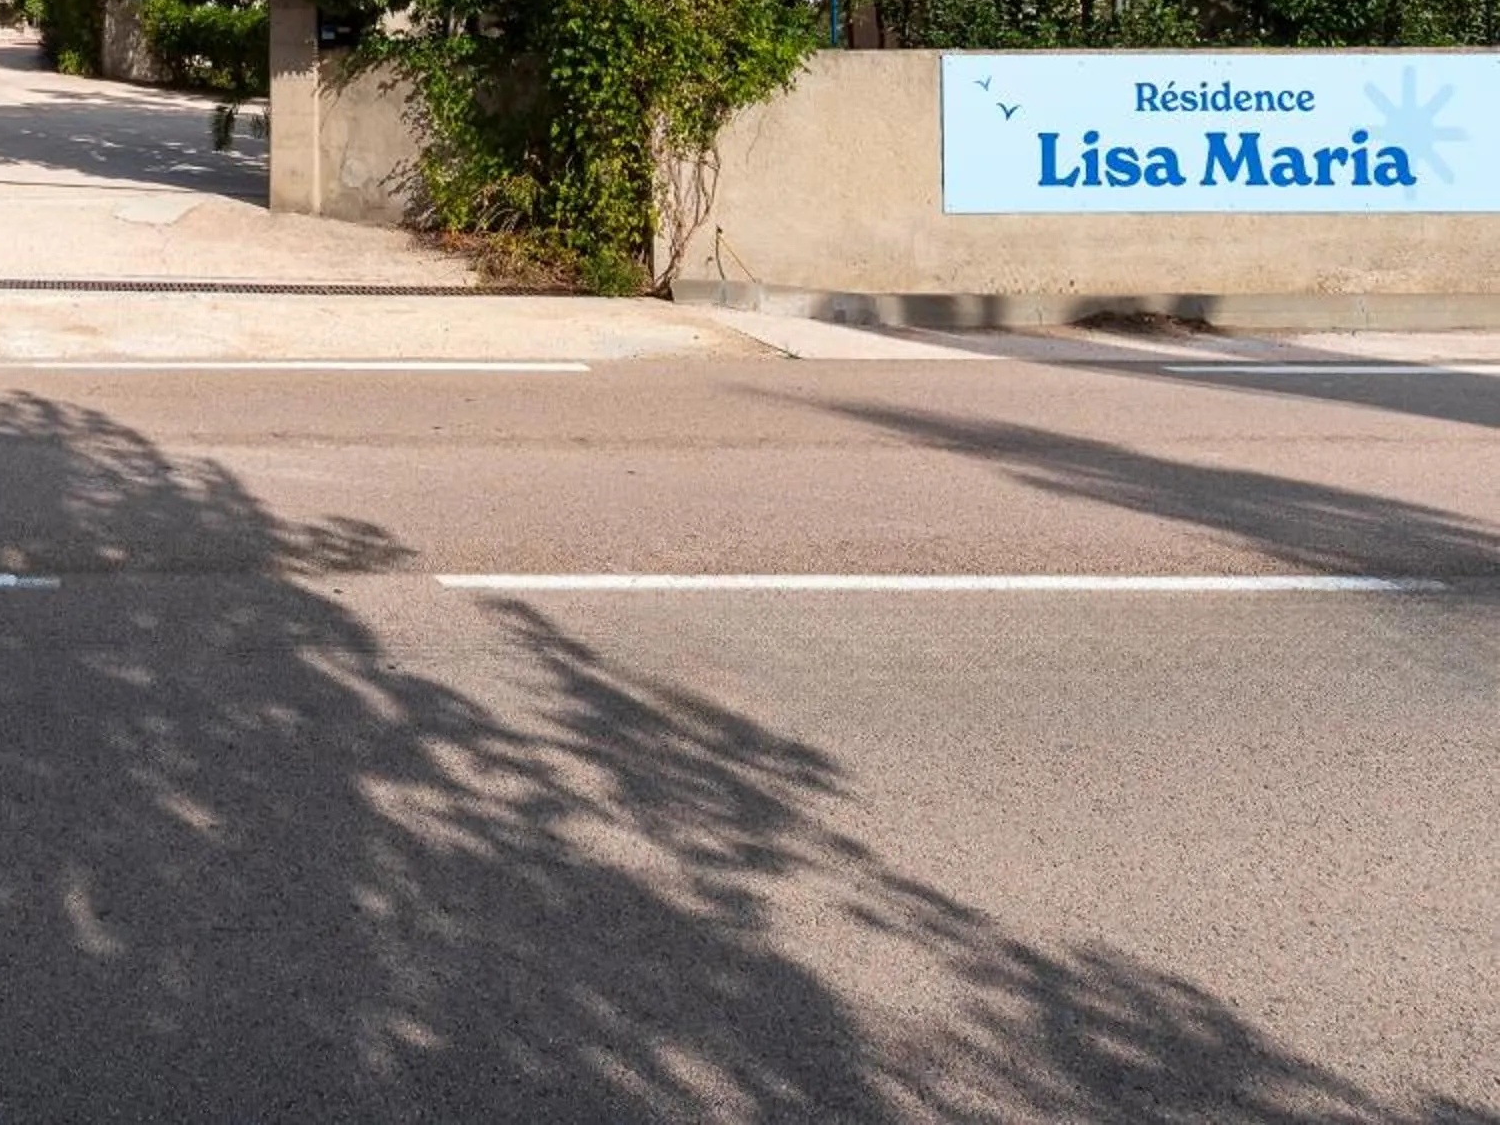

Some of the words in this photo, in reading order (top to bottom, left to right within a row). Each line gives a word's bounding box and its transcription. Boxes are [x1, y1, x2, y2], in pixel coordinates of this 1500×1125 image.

[1135, 80, 1315, 113] Résidence
[1037, 130, 1187, 188] Lisa
[1199, 129, 1418, 188] Maria
